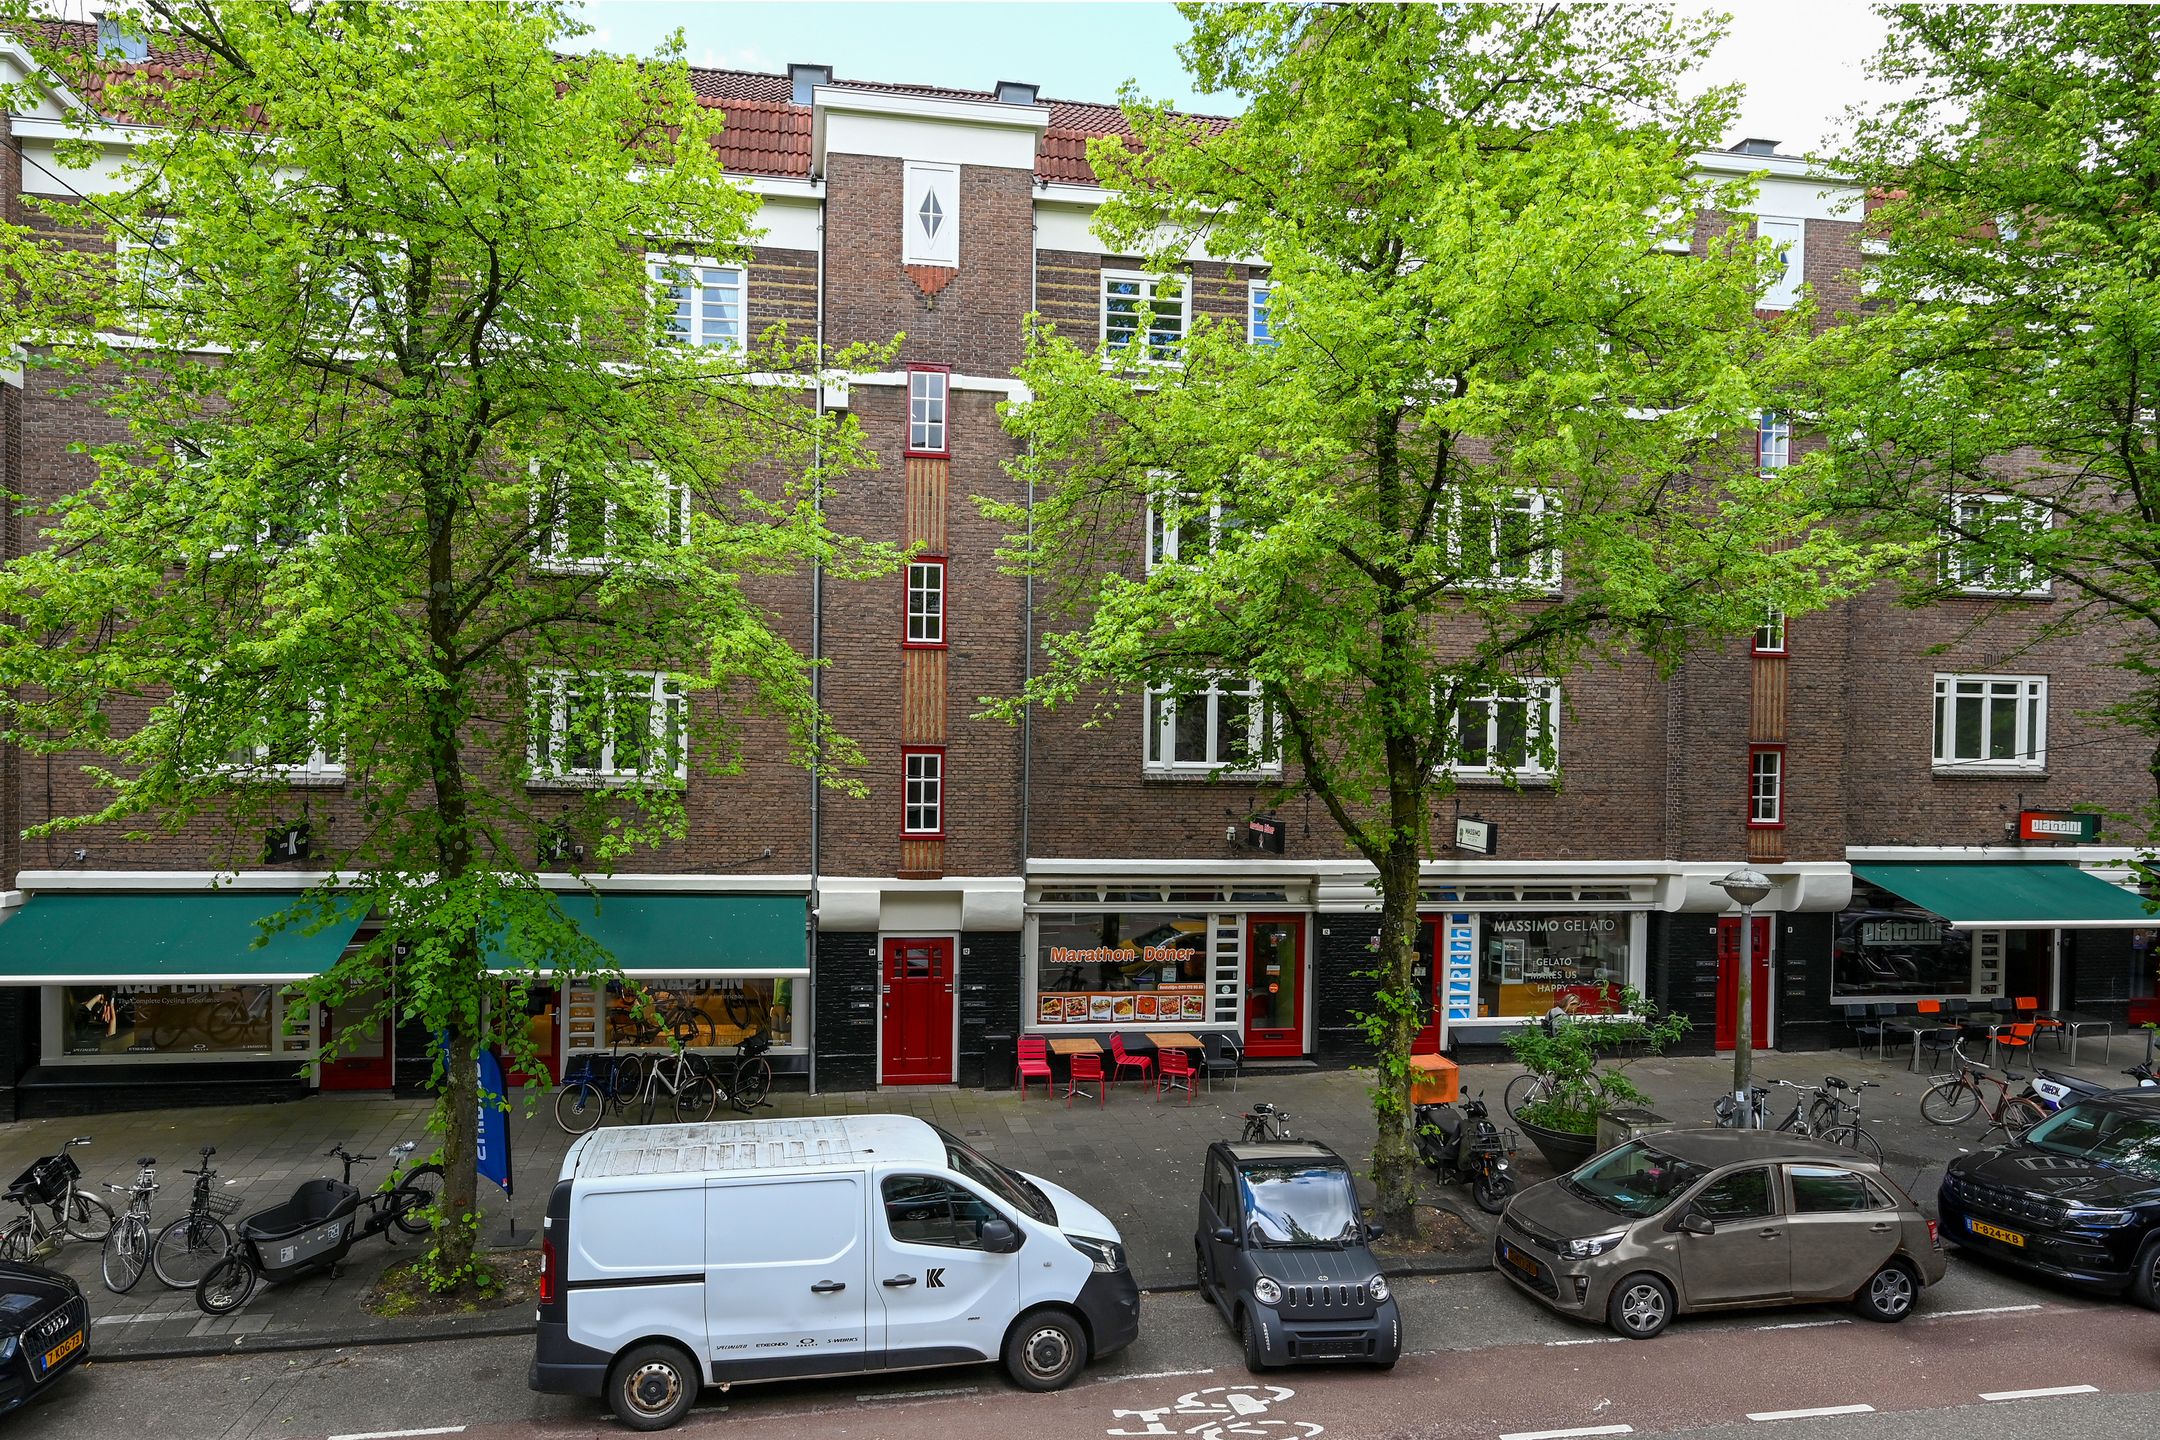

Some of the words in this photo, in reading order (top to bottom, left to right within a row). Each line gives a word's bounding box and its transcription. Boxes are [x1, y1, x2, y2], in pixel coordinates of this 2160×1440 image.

[1494, 920, 1559, 932] MASSIMO
[1564, 919, 1615, 932] GELATO
[1050, 946, 1135, 962] Marathon
[1143, 946, 1195, 962] Döner
[1536, 957, 1572, 966] GELATO
[1530, 971, 1562, 980] MAKES
[1565, 970, 1577, 979] US
[1537, 984, 1570, 993] HAPPY.
[162, 998, 185, 1006] Cycling
[1974, 1222, 2019, 1244] T-824-KB
[48, 1334, 80, 1364] 7-KDG-73
